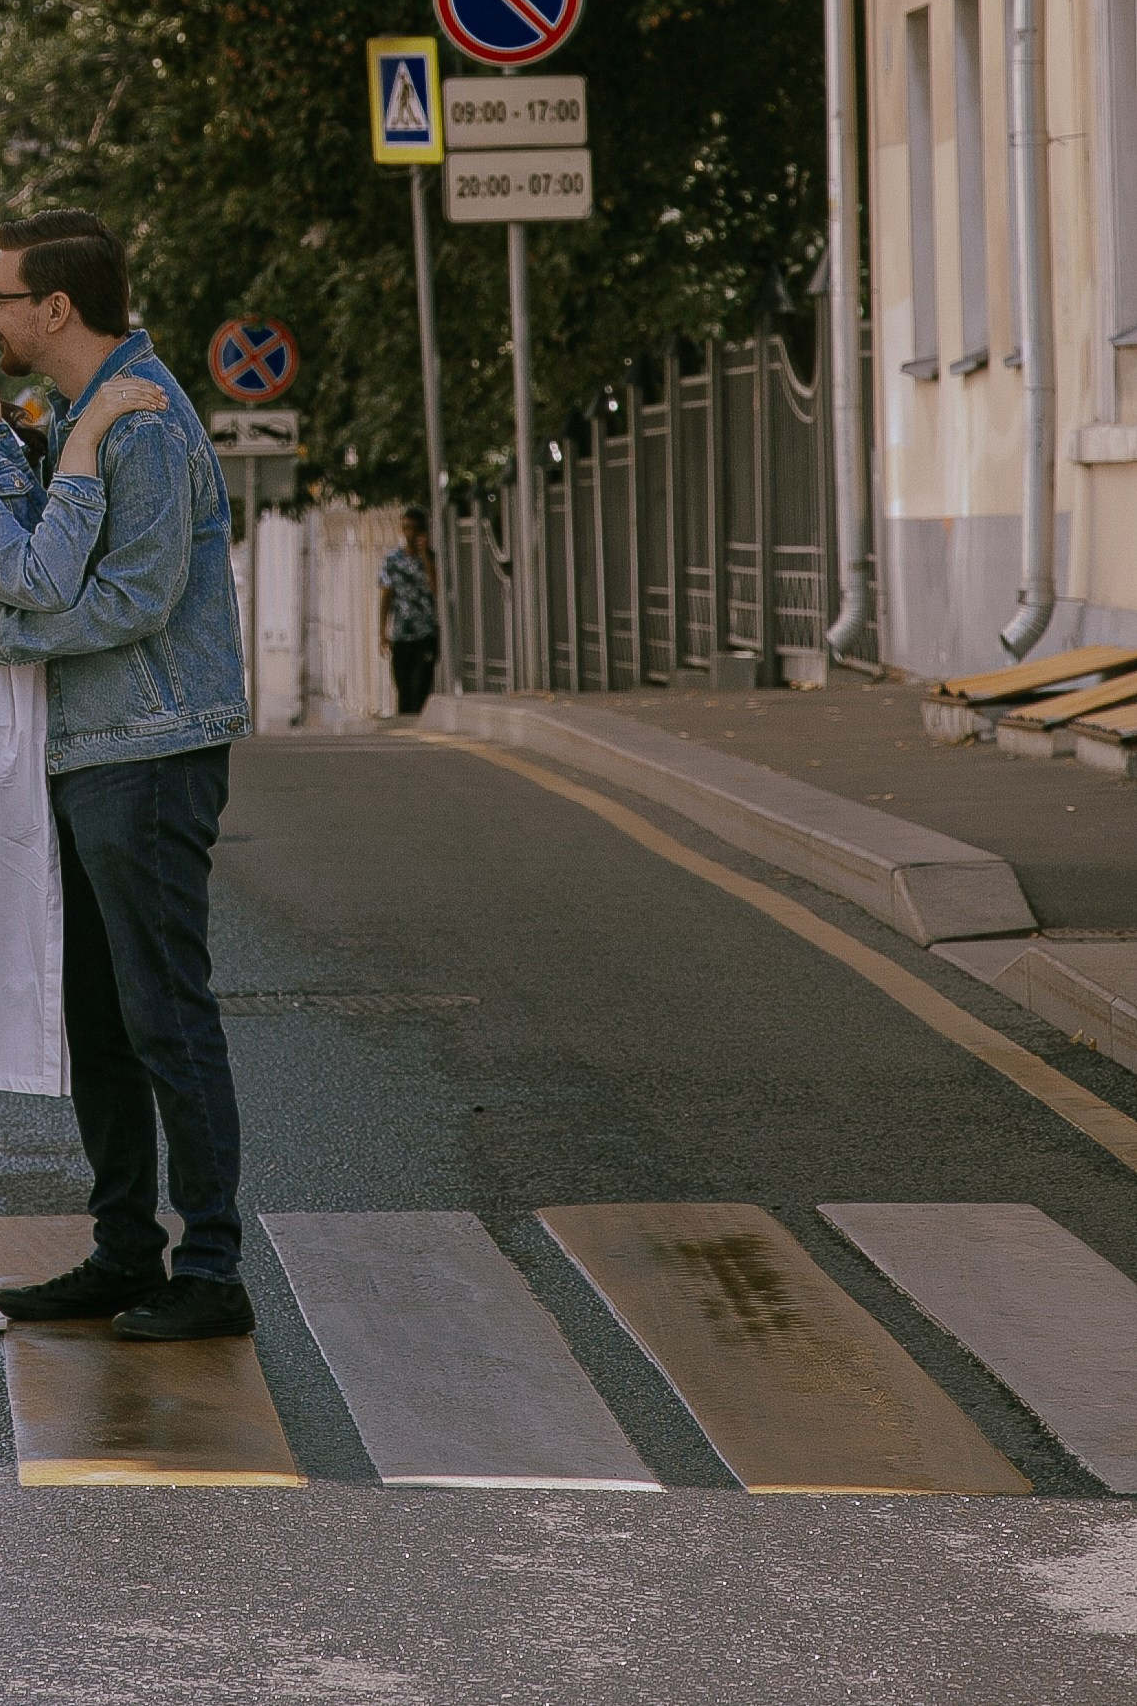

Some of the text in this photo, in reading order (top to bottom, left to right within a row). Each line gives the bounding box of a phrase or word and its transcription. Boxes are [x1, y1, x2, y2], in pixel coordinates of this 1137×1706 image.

[451, 100, 506, 124] 09:00
[527, 98, 580, 123] 17:00
[456, 174, 510, 198] 20:00
[528, 173, 583, 196] 07:00
